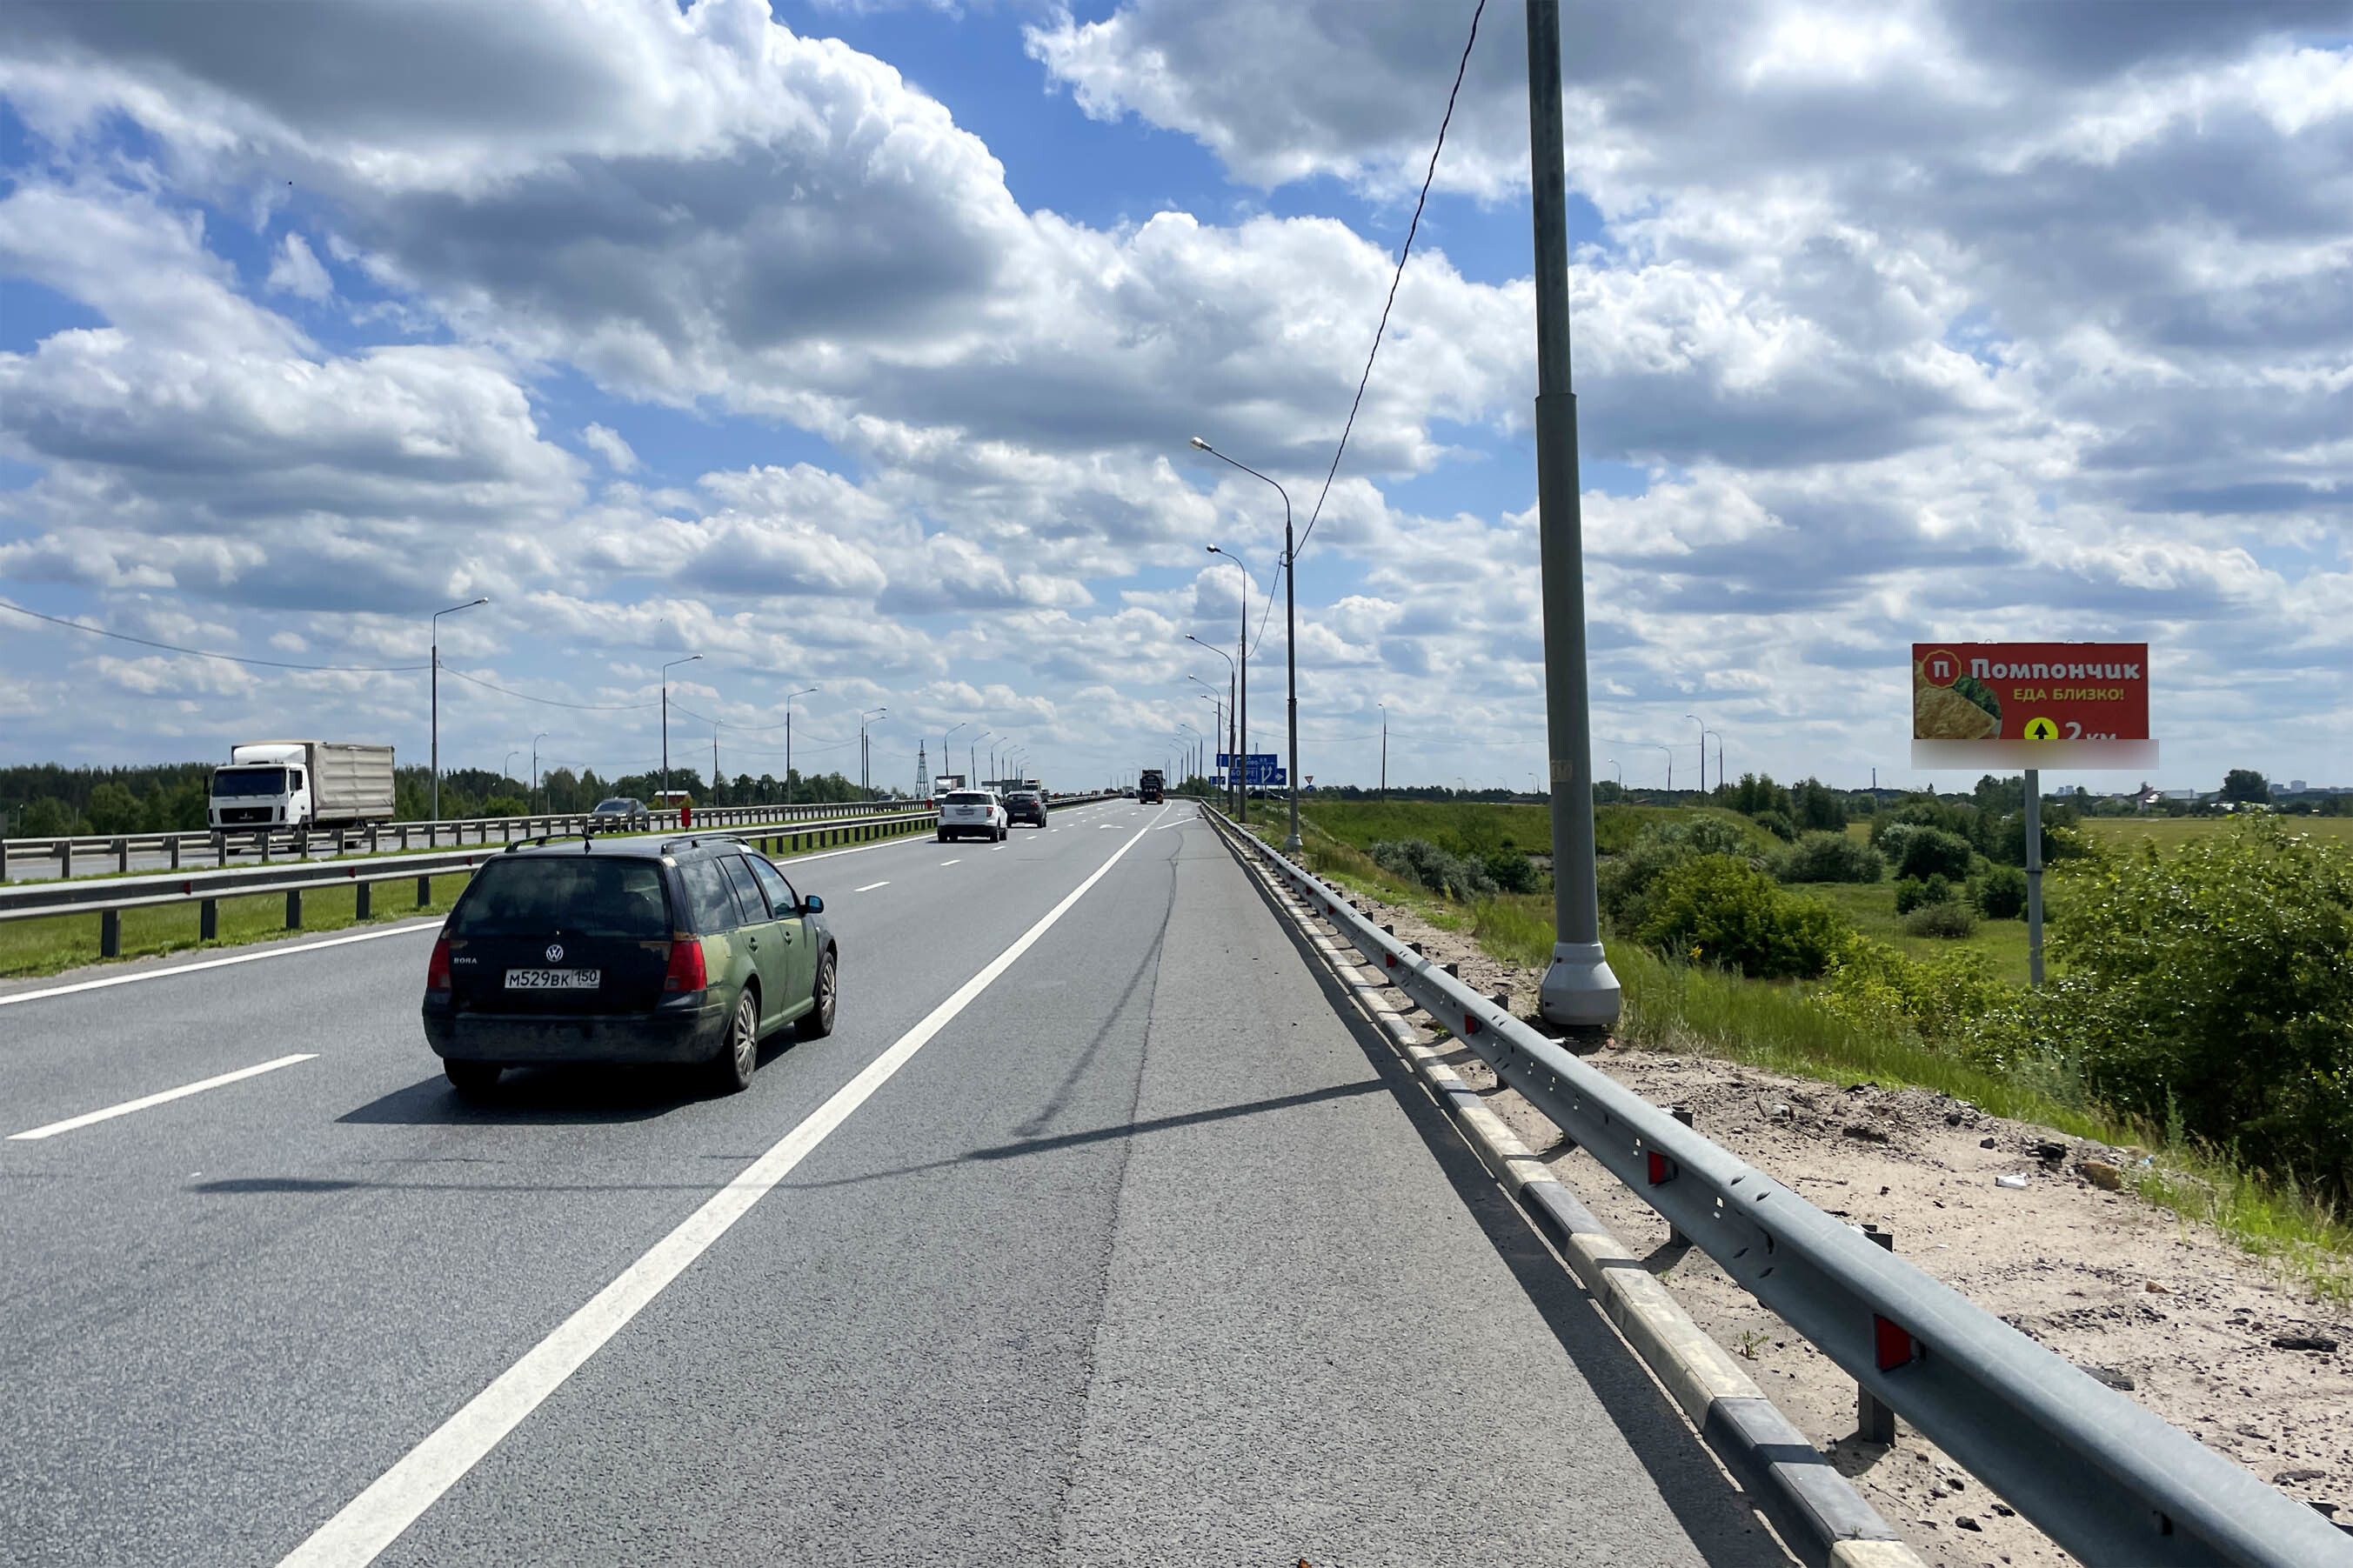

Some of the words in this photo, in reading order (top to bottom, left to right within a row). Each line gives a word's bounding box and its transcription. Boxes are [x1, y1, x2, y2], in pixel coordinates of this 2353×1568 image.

[1969, 658, 2140, 679] Помпончик
[2013, 688, 2047, 703] ЕДА
[2053, 688, 2124, 701] БЛИЗКО!
[574, 970, 597, 982] 150
